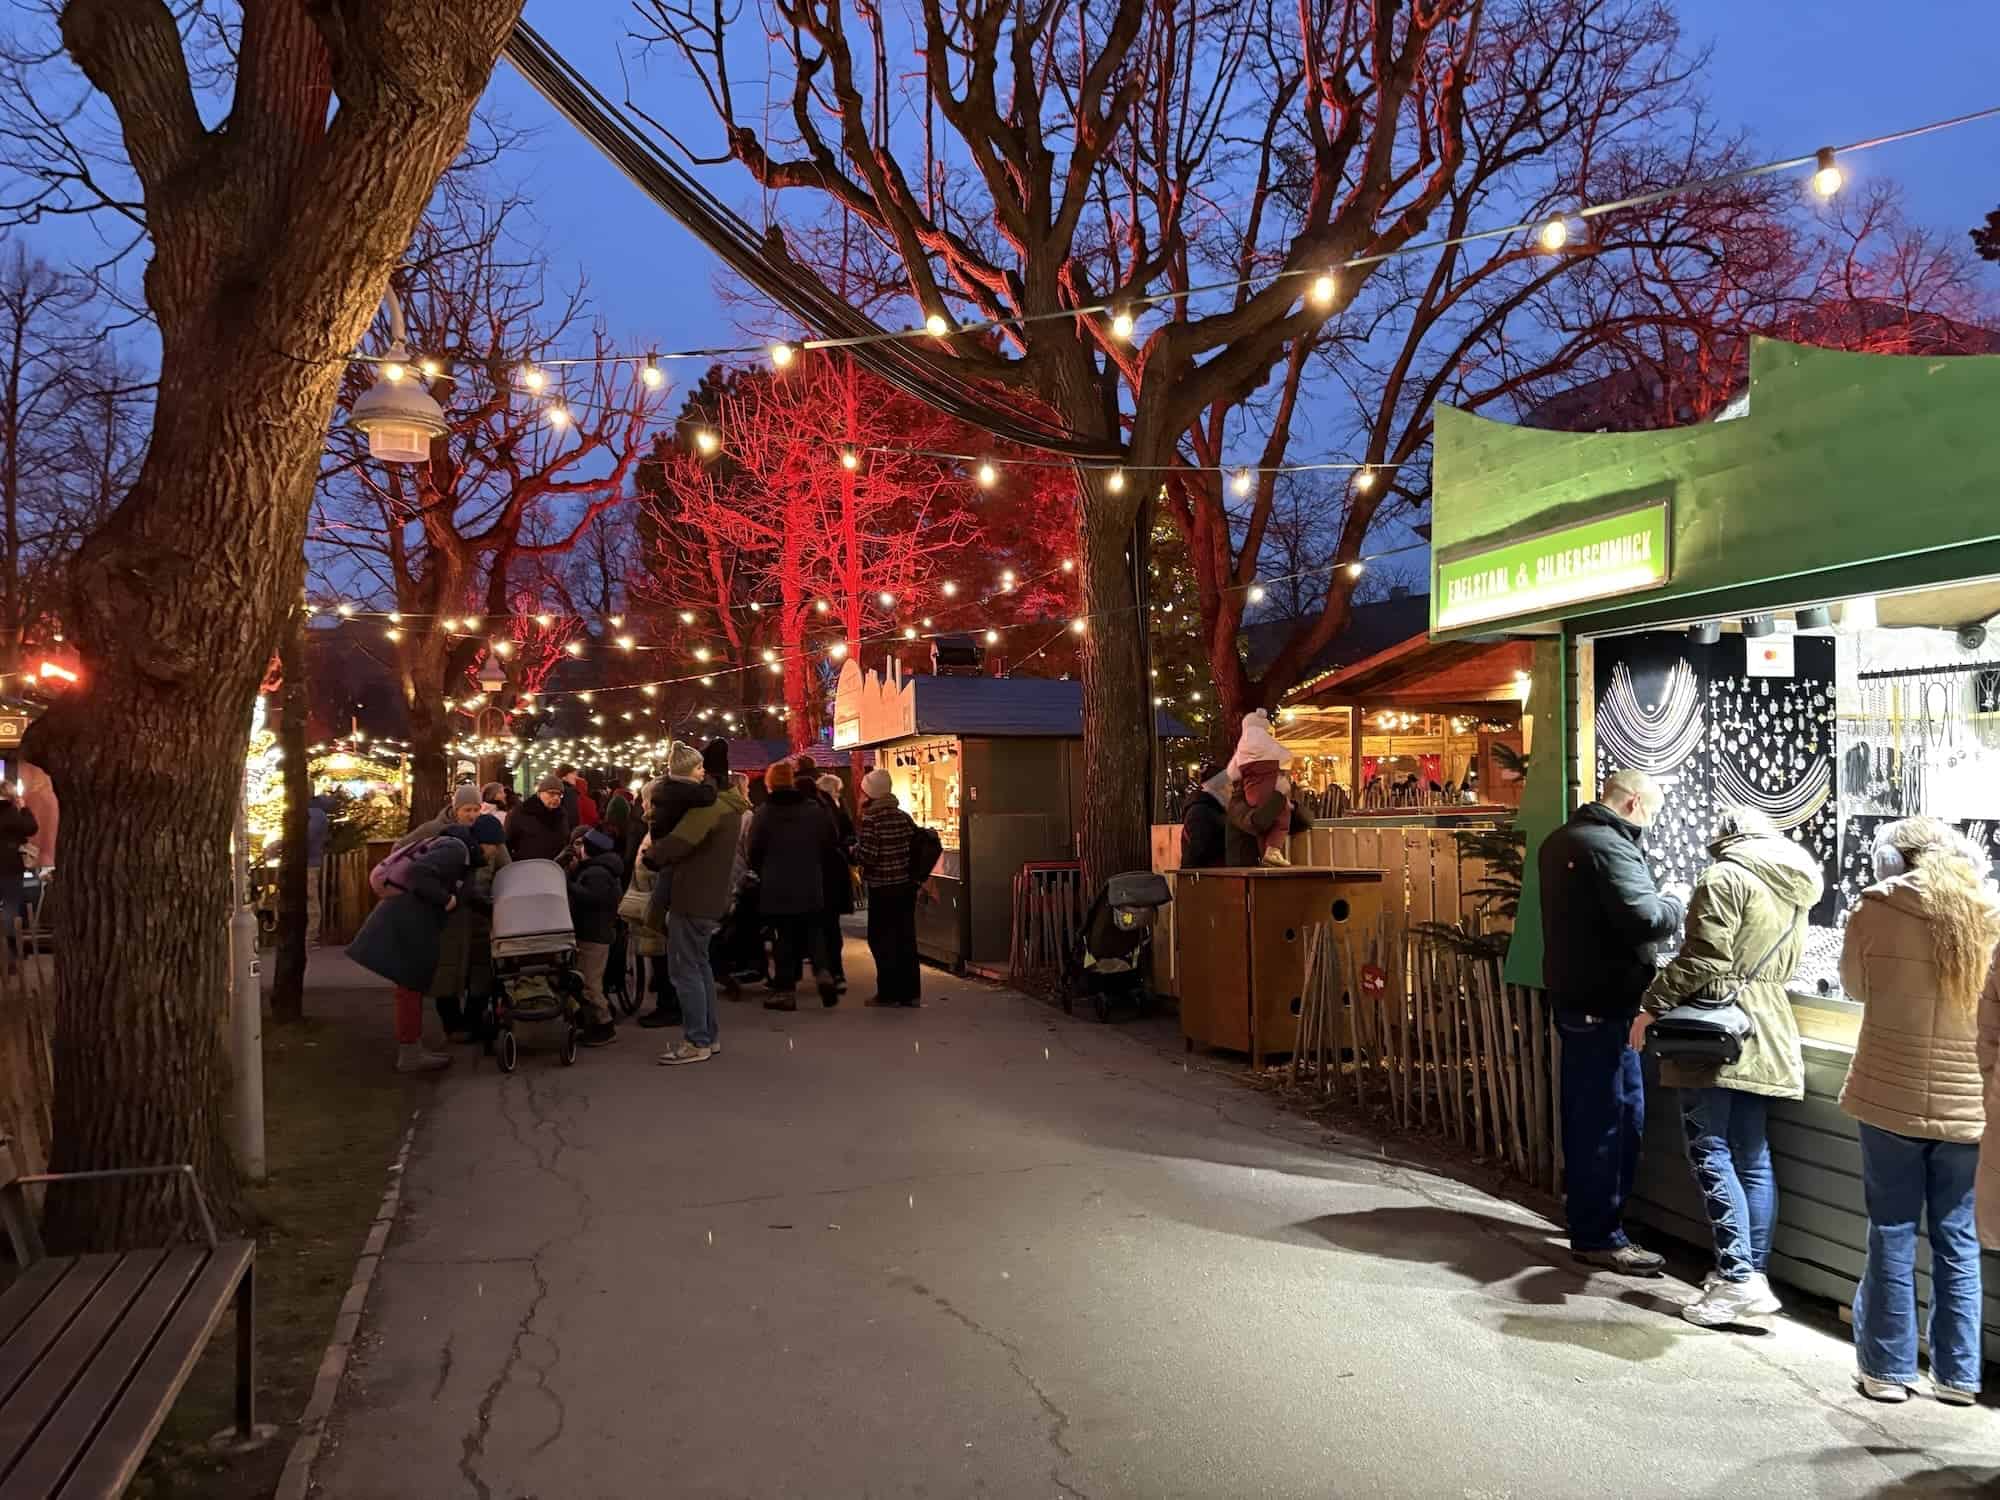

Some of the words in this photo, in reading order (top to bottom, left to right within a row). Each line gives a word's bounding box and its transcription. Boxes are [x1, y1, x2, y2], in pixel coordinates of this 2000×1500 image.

[1448, 567, 1509, 602] EDELSTAHL
[1516, 562, 1529, 586] &
[1536, 529, 1652, 578] SILBERSCHMUCK
